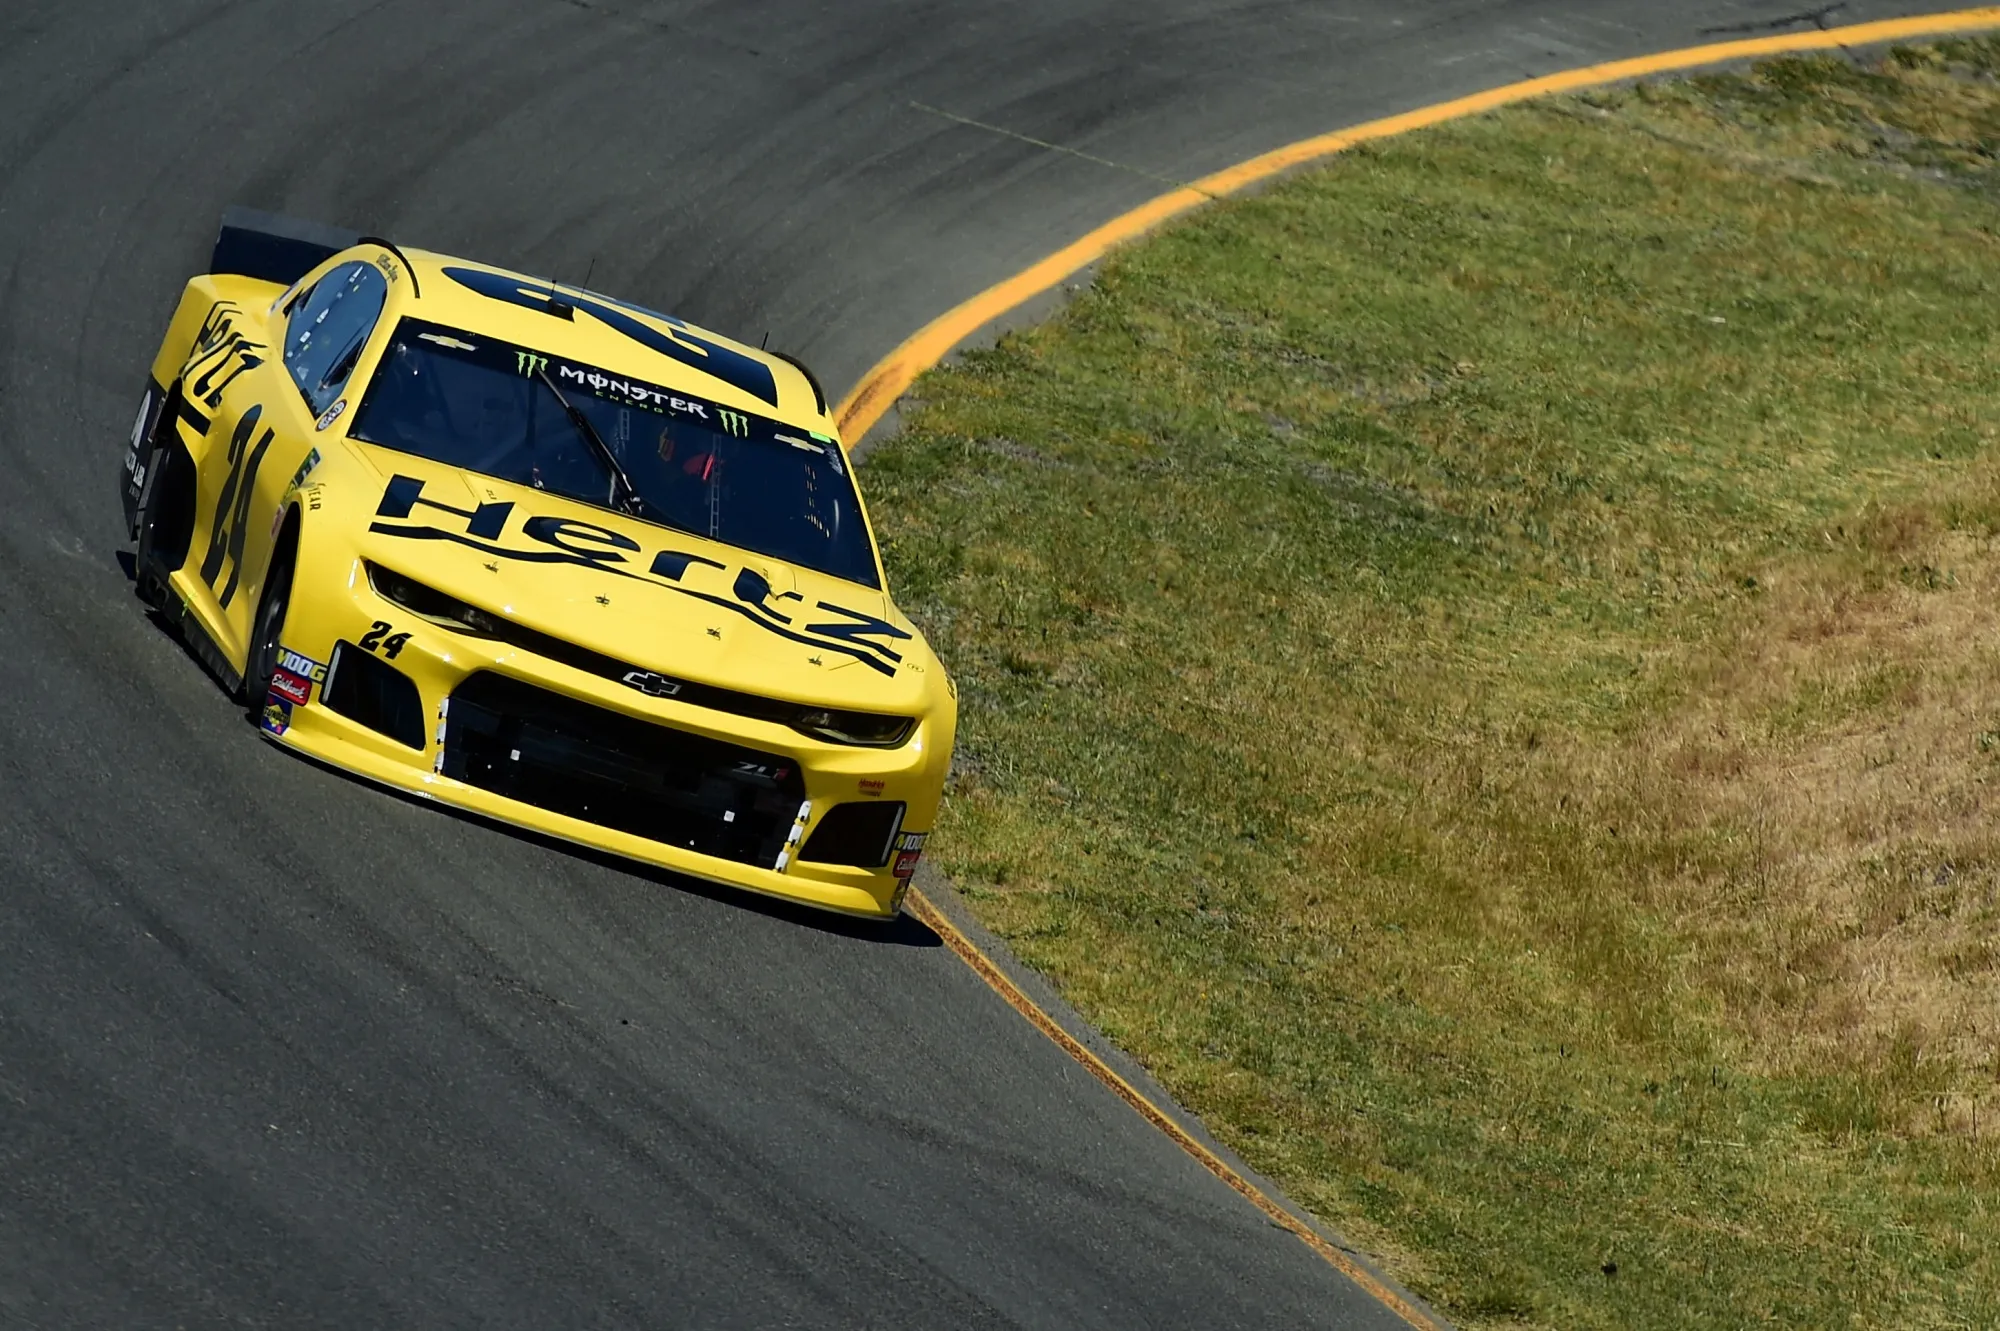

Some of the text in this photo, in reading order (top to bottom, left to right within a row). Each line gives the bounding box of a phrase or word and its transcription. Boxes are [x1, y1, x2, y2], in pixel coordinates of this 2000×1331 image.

[560, 366, 709, 419] MONSTER
[596, 390, 677, 417] ENERGY
[201, 404, 275, 612] 24
[376, 474, 913, 664] Hertz
[358, 620, 414, 660] 24
